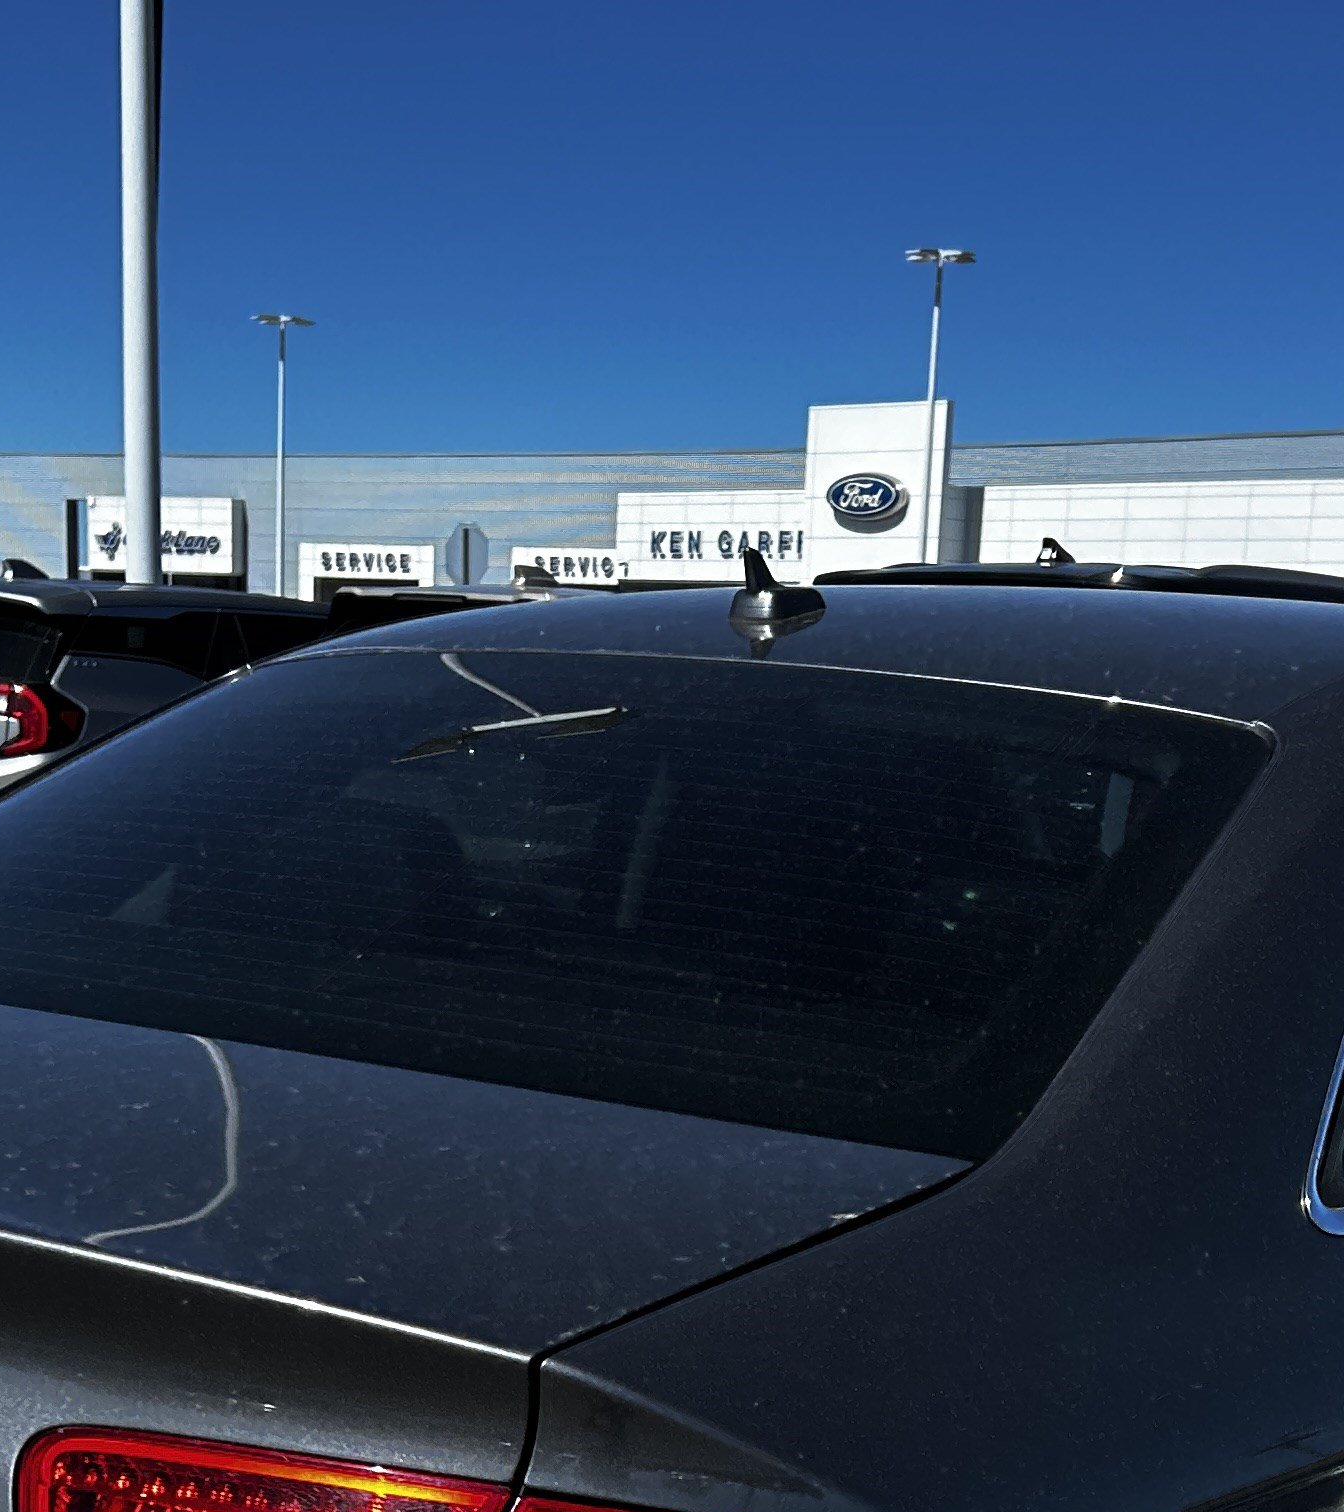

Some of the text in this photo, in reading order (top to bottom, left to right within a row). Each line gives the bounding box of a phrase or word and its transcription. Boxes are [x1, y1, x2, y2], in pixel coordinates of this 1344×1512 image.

[839, 483, 884, 508] Ford
[651, 530, 702, 558] KEN
[321, 552, 411, 573] SERVICE
[535, 556, 616, 578] SERVIC
